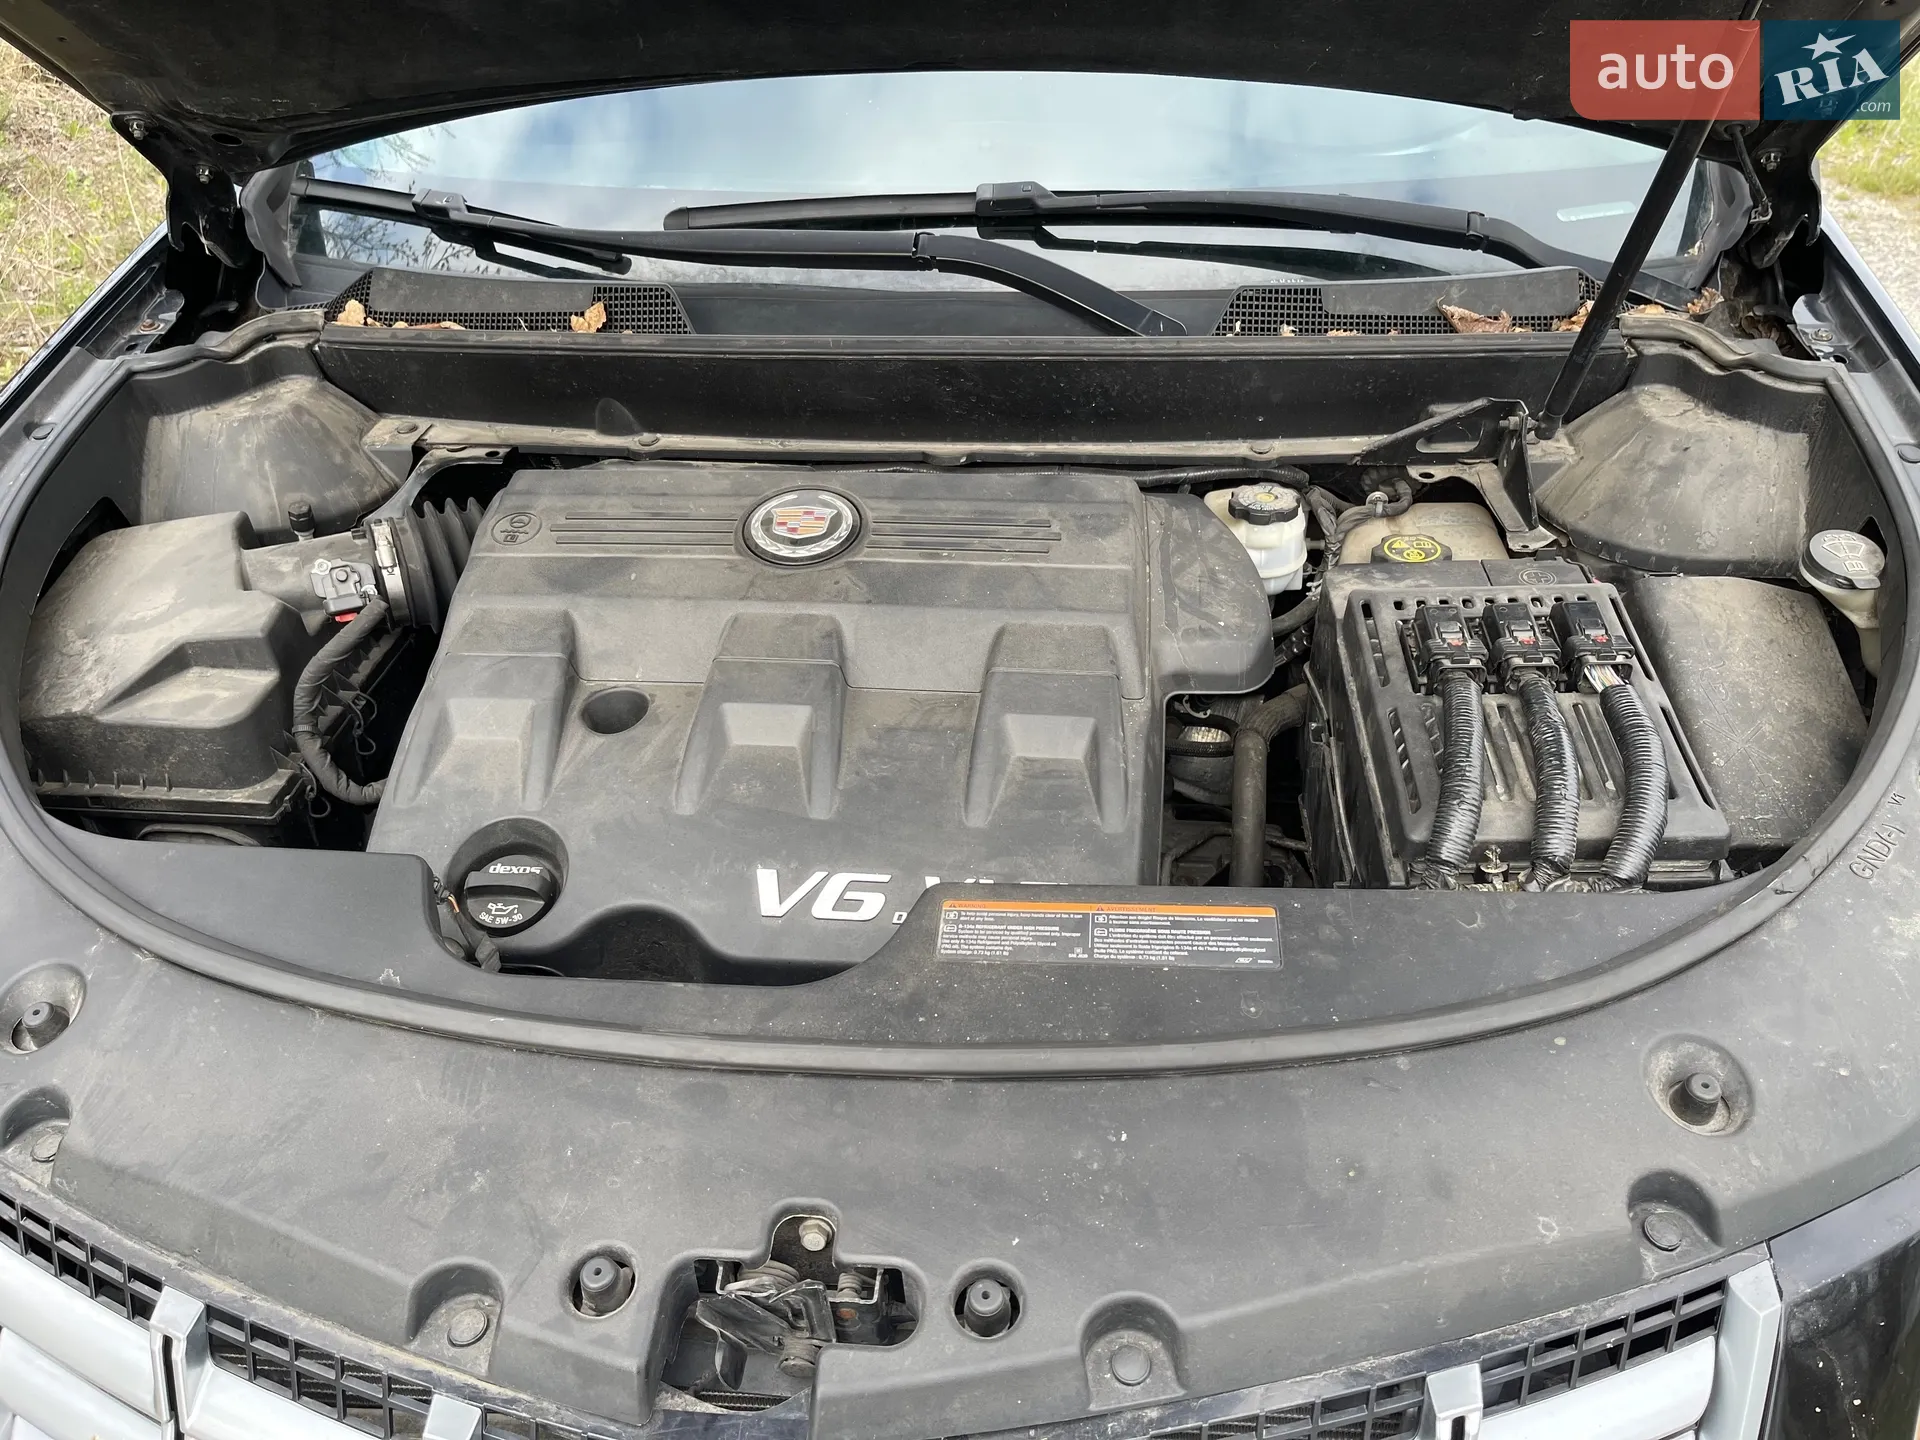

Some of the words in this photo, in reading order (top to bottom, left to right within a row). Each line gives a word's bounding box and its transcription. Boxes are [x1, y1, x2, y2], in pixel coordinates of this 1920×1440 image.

[488, 863, 544, 875] dexos
[756, 868, 893, 922] V6
[479, 911, 494, 924] SAE
[495, 913, 523, 925] 5W-30
